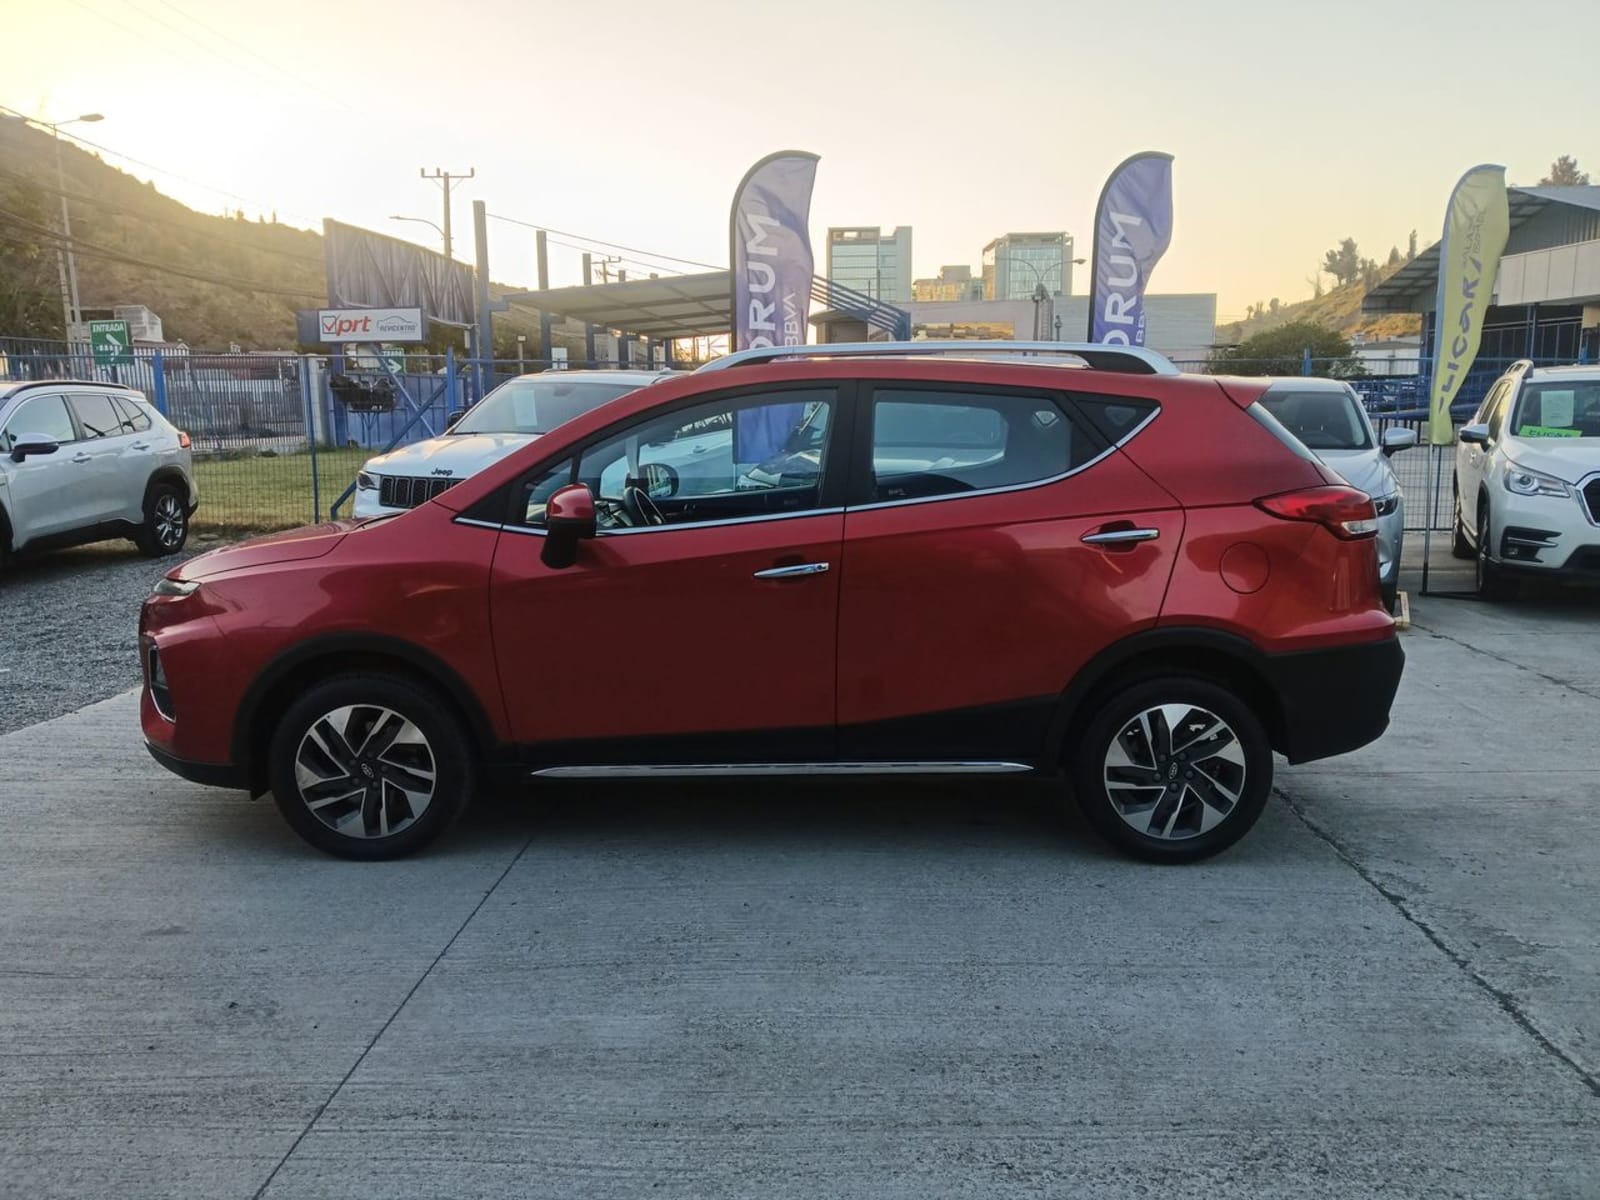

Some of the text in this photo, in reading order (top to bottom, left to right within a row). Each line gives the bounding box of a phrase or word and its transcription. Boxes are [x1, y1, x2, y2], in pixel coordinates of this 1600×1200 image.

[92, 322, 125, 333] ENTRADA
[336, 316, 372, 336] prt
[431, 467, 454, 477] Jeep
